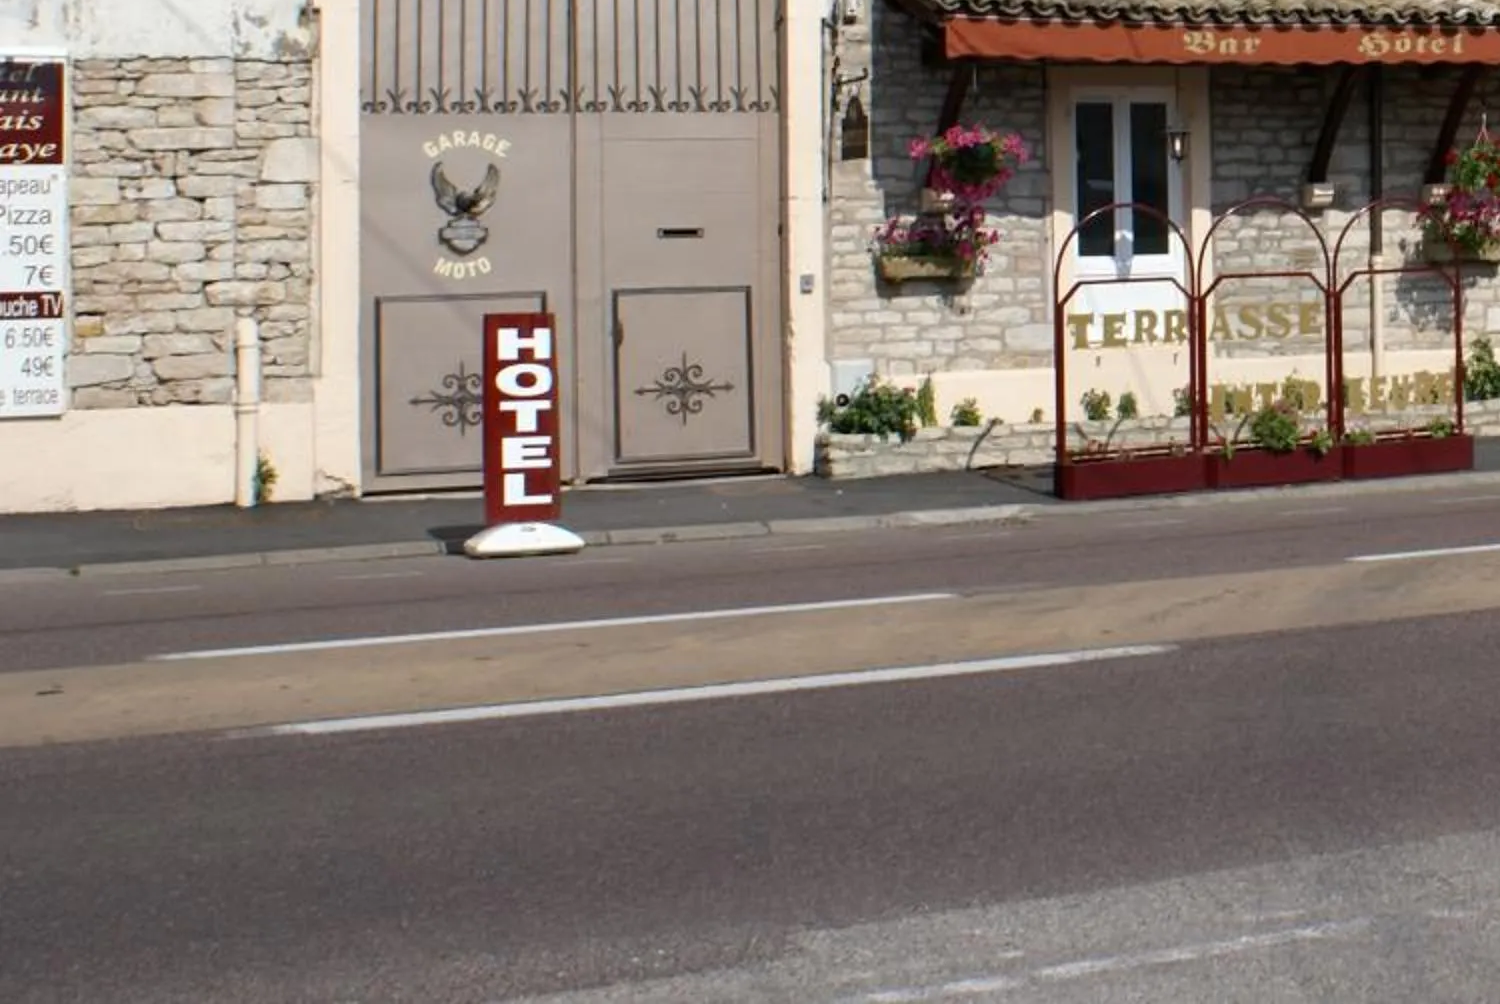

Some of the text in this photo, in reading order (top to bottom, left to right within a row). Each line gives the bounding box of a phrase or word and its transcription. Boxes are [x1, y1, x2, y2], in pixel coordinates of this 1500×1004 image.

[1183, 30, 1261, 56] Bar
[1357, 32, 1465, 57] Hôtel
[423, 130, 512, 158] GARAGE
[24, 265, 54, 286] 7€
[433, 256, 492, 280] MOTO
[40, 294, 61, 317] TV
[1067, 302, 1324, 350] TERRASSE
[21, 355, 54, 377] 49€
[495, 328, 553, 506] HOTEL
